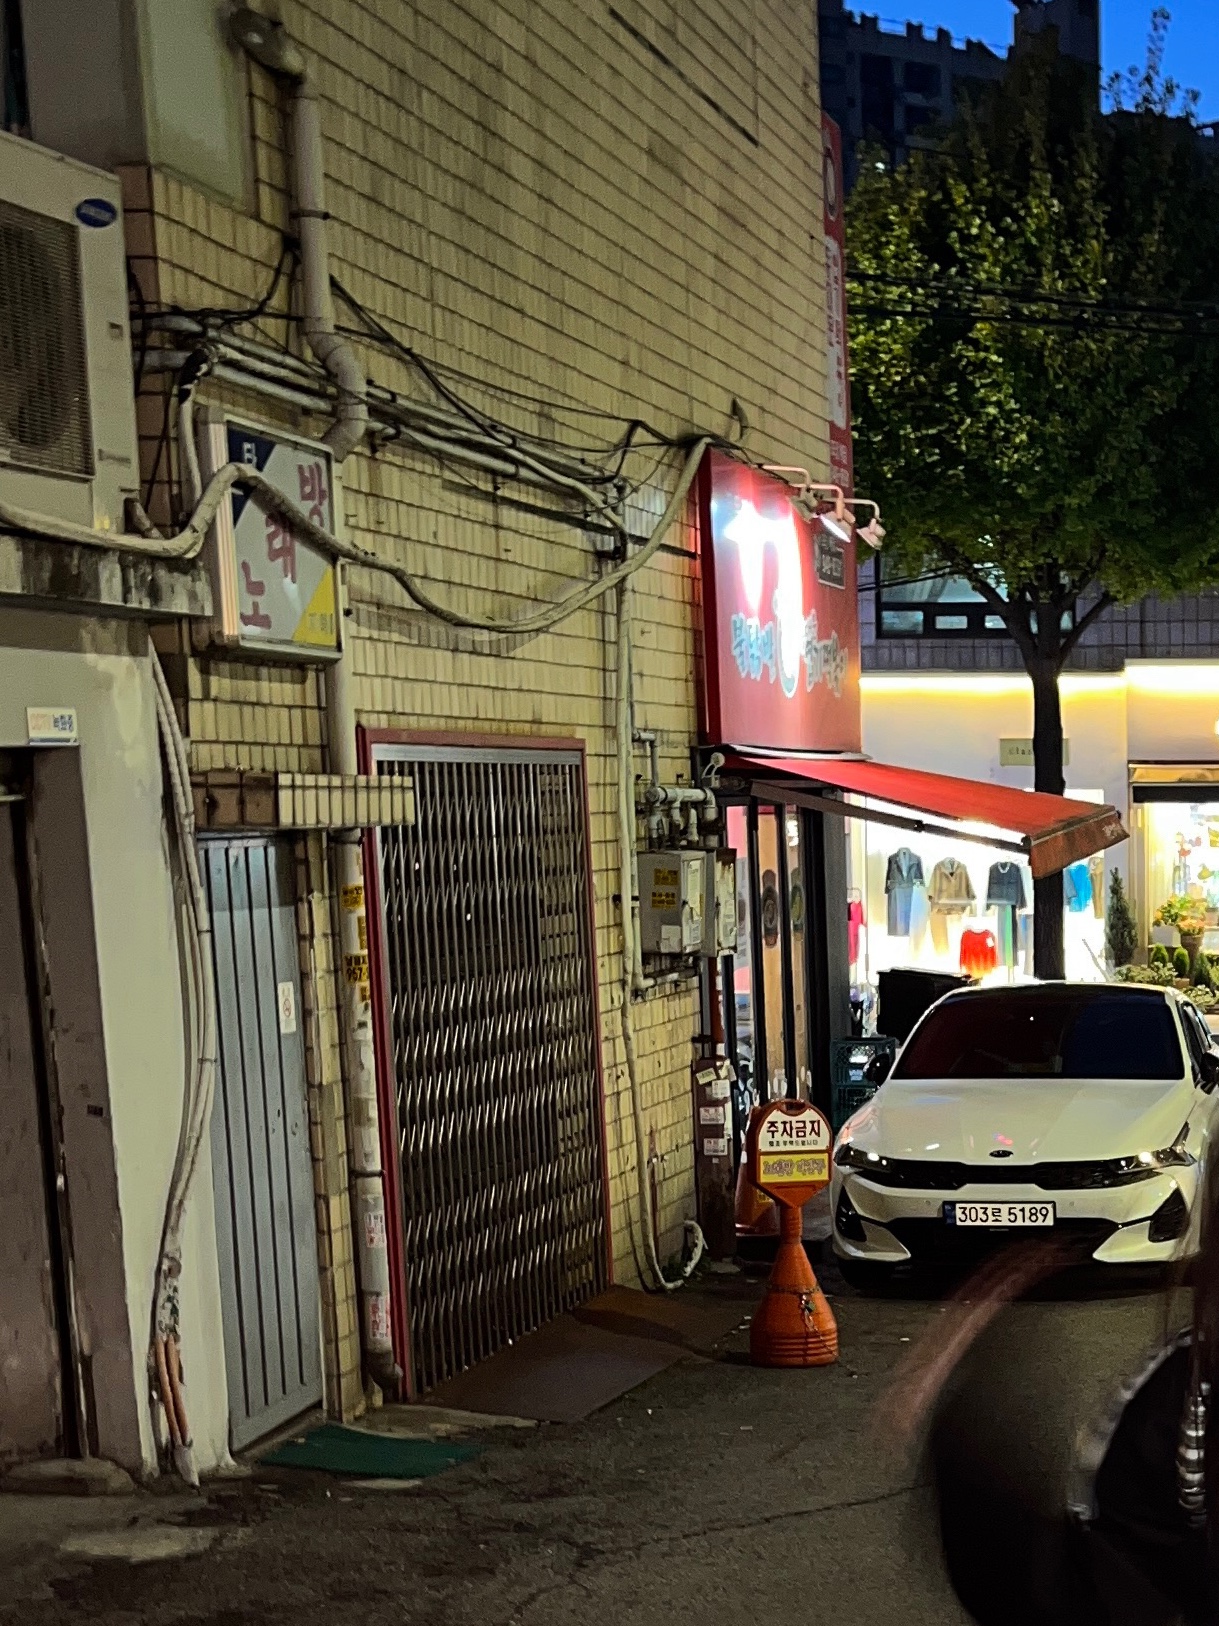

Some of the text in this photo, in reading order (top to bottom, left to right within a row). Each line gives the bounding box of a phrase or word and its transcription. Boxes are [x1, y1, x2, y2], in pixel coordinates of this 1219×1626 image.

[766, 1119, 821, 1139] 주차금지
[958, 1206, 1049, 1224] 303로 5189
